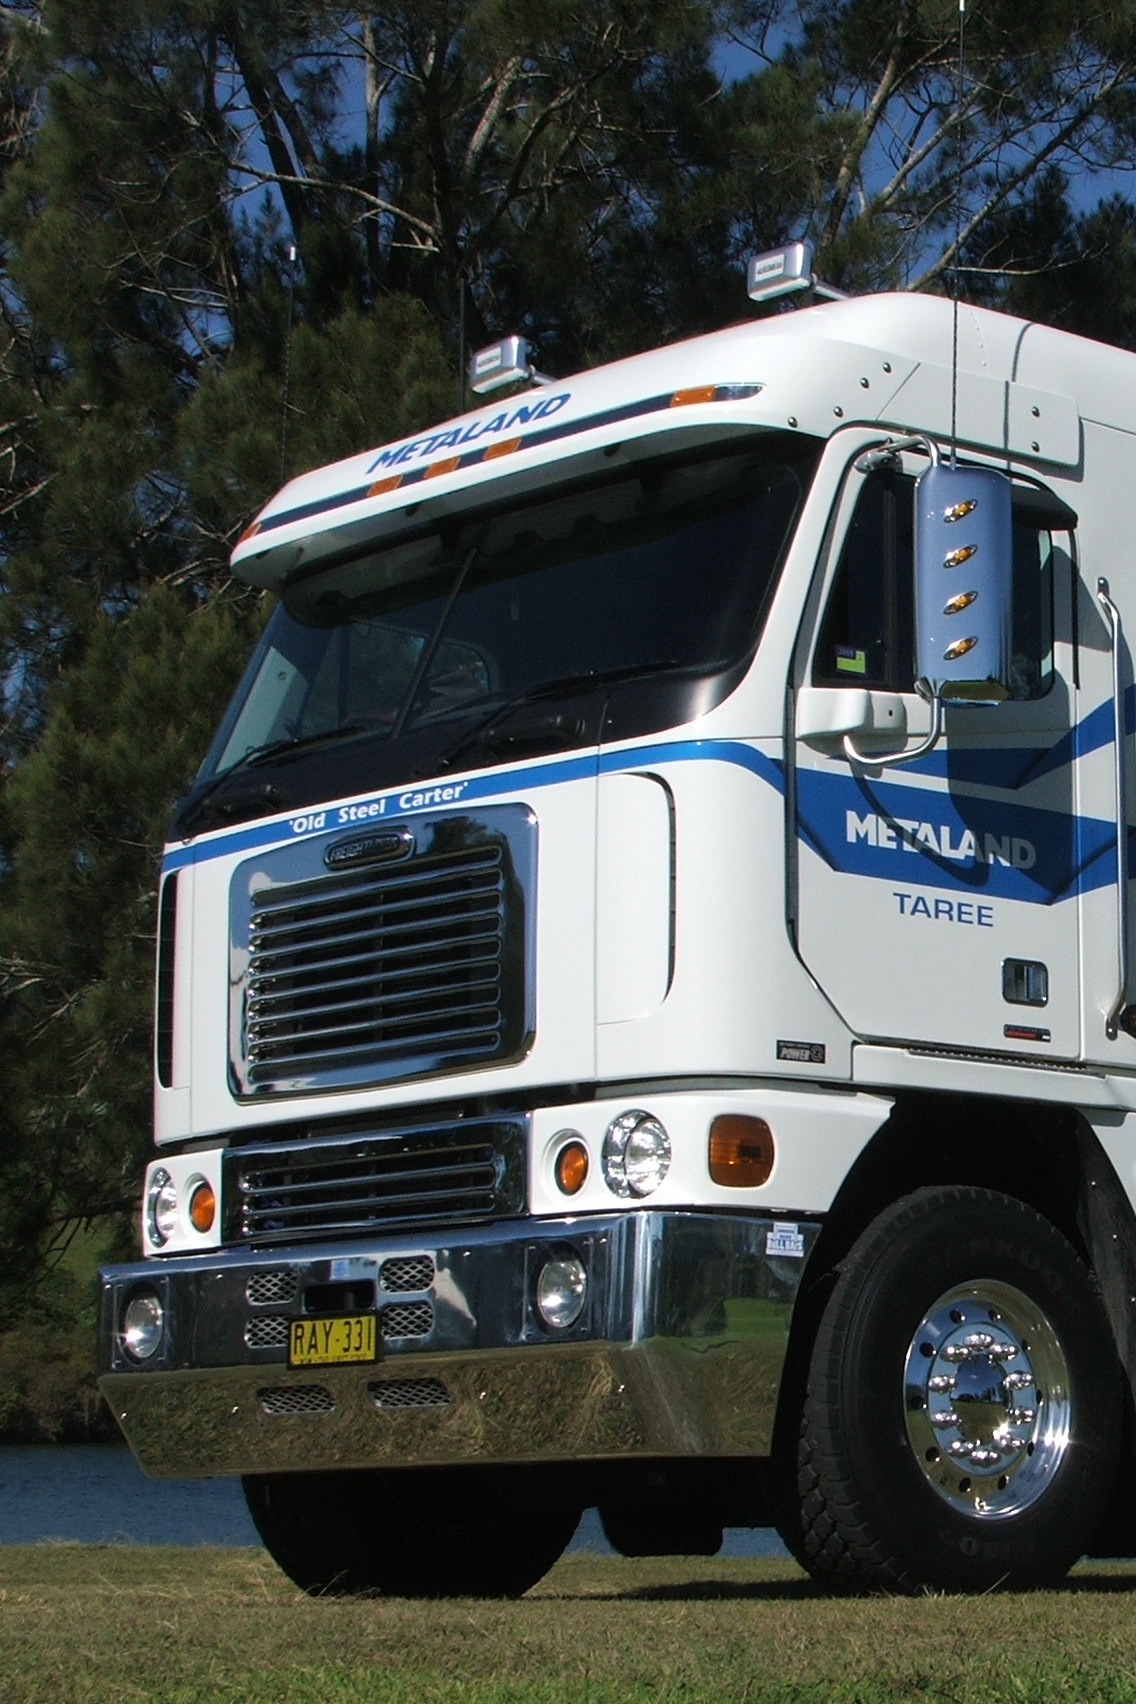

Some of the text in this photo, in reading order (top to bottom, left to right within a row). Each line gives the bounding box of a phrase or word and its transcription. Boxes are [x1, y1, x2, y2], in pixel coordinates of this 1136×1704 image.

[367, 393, 572, 475] METALAND
[337, 799, 386, 823] Steel
[845, 810, 1037, 870] METALAND
[892, 892, 995, 928] TAREE
